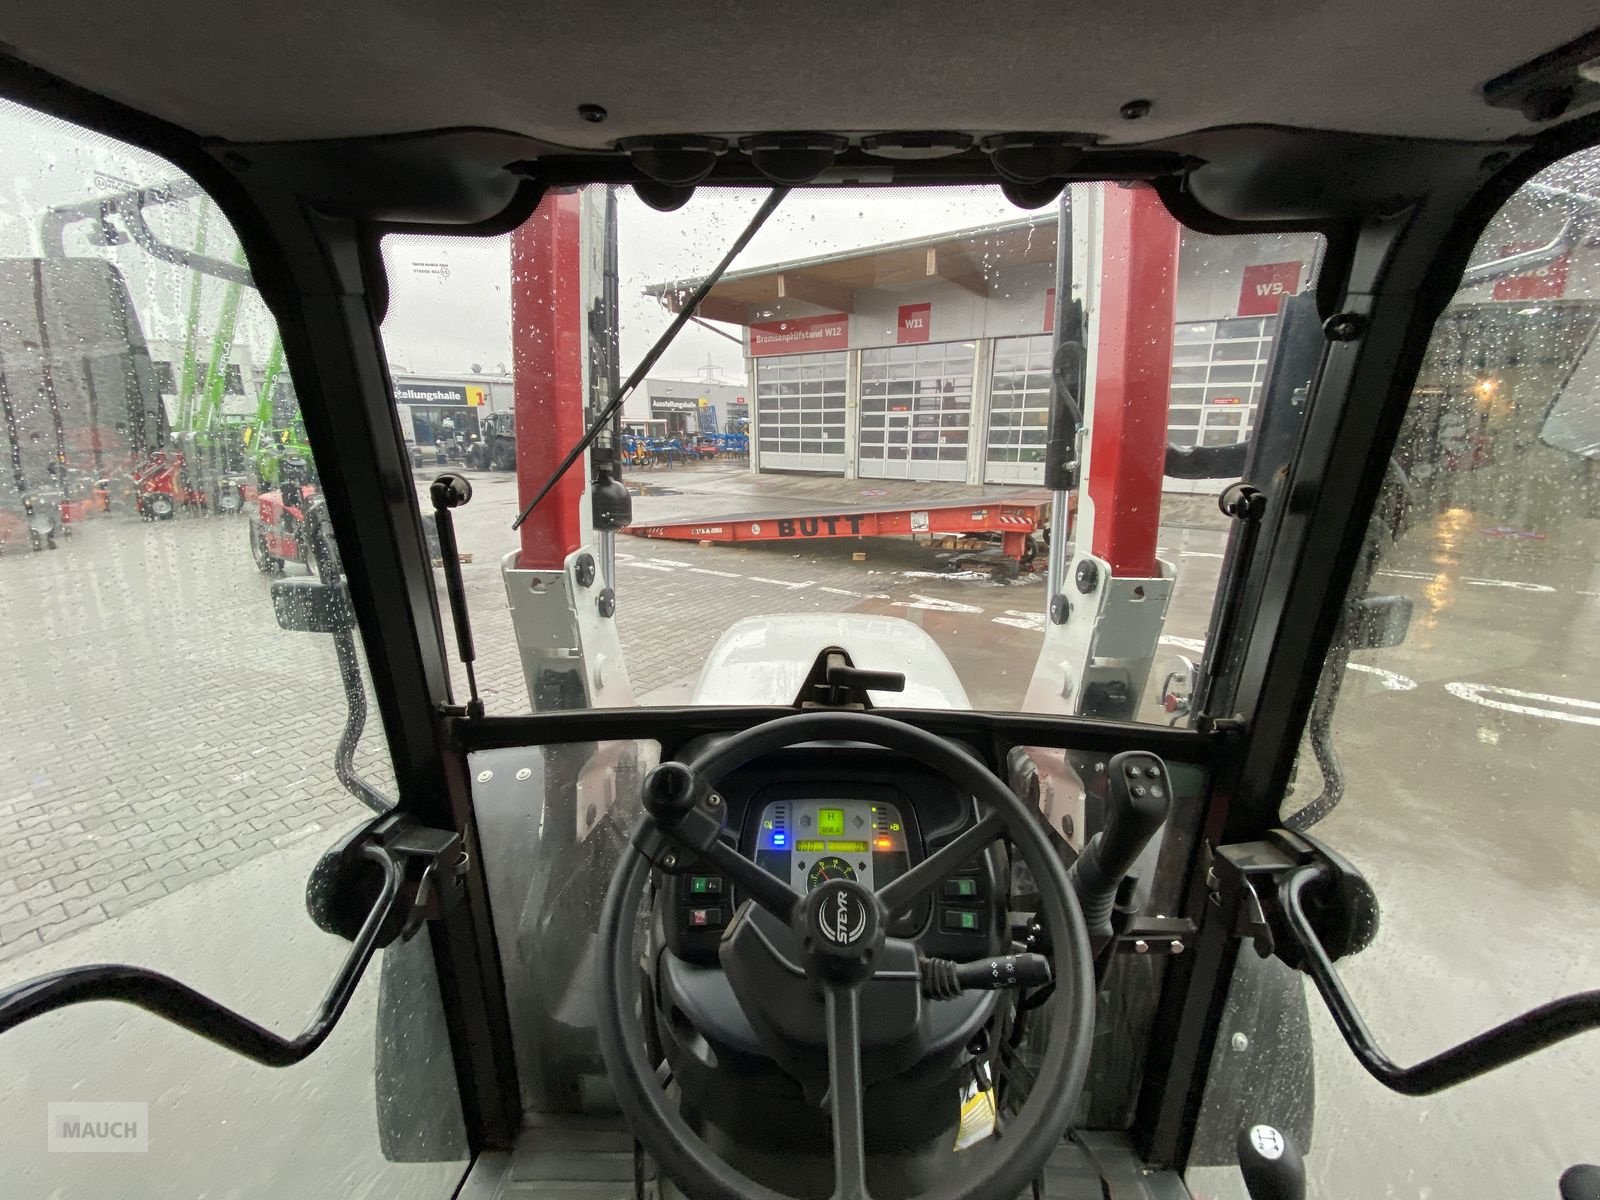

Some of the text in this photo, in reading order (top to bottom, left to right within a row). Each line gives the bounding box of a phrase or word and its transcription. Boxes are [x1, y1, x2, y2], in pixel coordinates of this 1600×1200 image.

[1256, 282, 1283, 296] W9
[905, 318, 923, 329] W11
[756, 327, 842, 344] Bremsenprüfstand W12
[476, 391, 485, 406] 1
[778, 513, 865, 538] BUTT
[837, 891, 848, 945] STEYR
